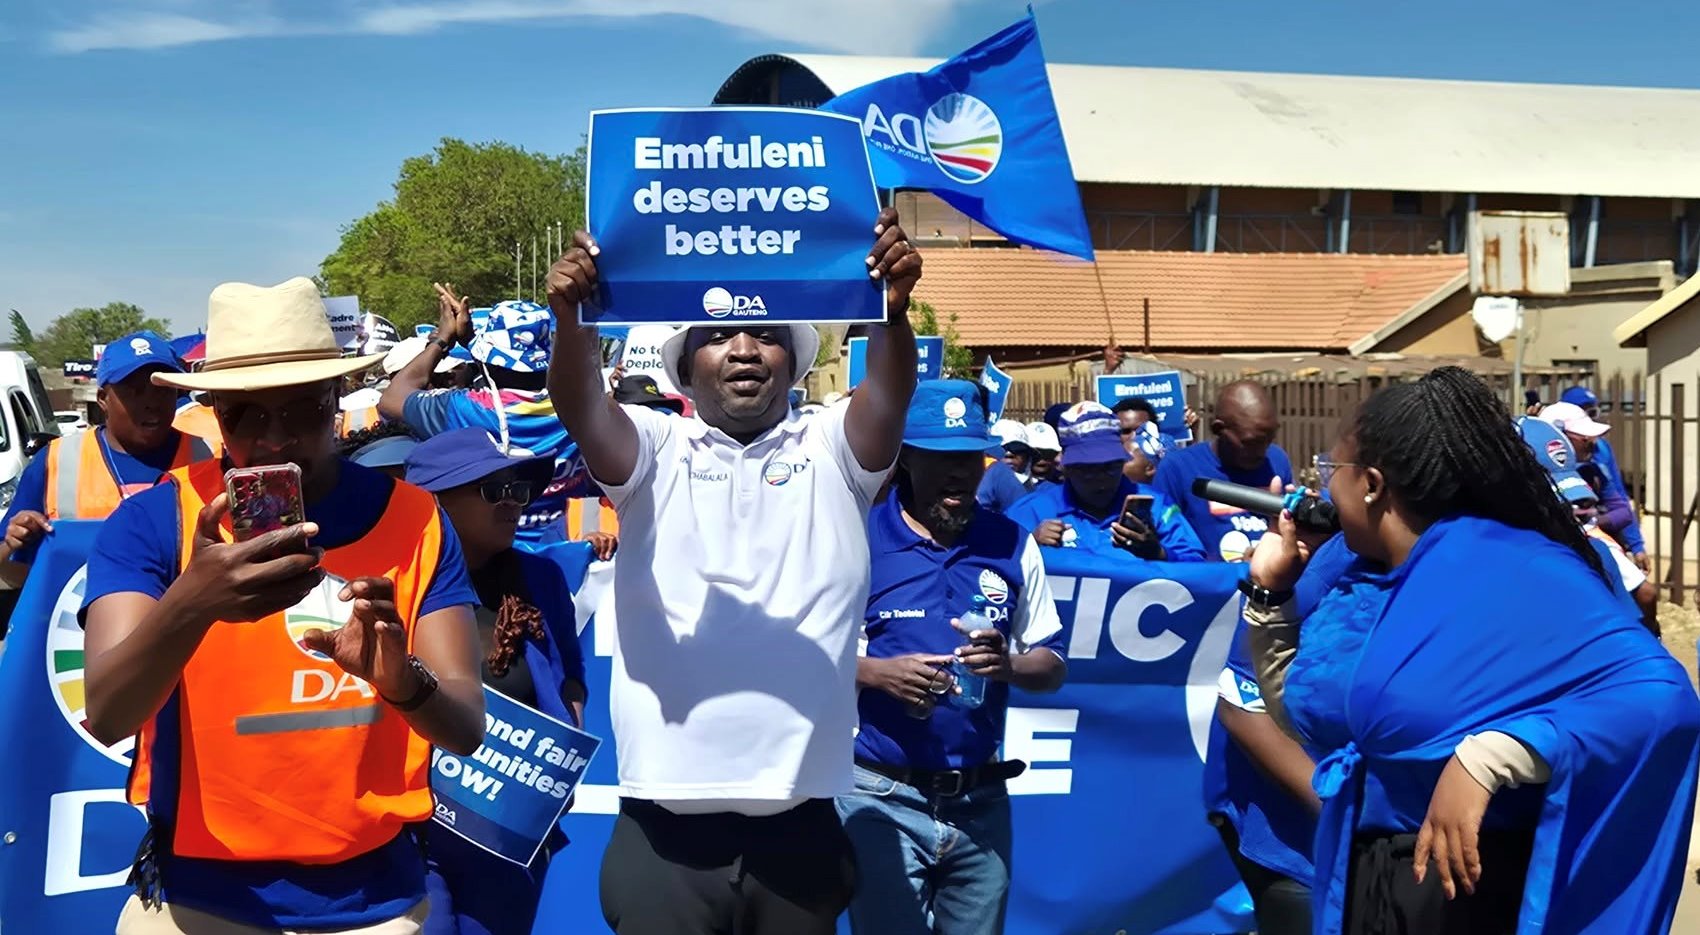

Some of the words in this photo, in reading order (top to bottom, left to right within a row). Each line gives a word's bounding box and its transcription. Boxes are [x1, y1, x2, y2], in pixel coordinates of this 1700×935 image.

[635, 135, 826, 169] Emfuleni
[633, 181, 830, 214] deserves
[665, 224, 801, 255] better
[733, 295, 766, 310] DA
[326, 313, 354, 323] adre
[629, 346, 646, 355] No
[626, 359, 664, 370] Deplo
[1115, 381, 1173, 397] Emfuleni
[945, 418, 967, 428] DA
[985, 606, 1009, 621] DA
[290, 669, 375, 703] DA
[534, 737, 588, 773] fair
[472, 744, 570, 799] unities
